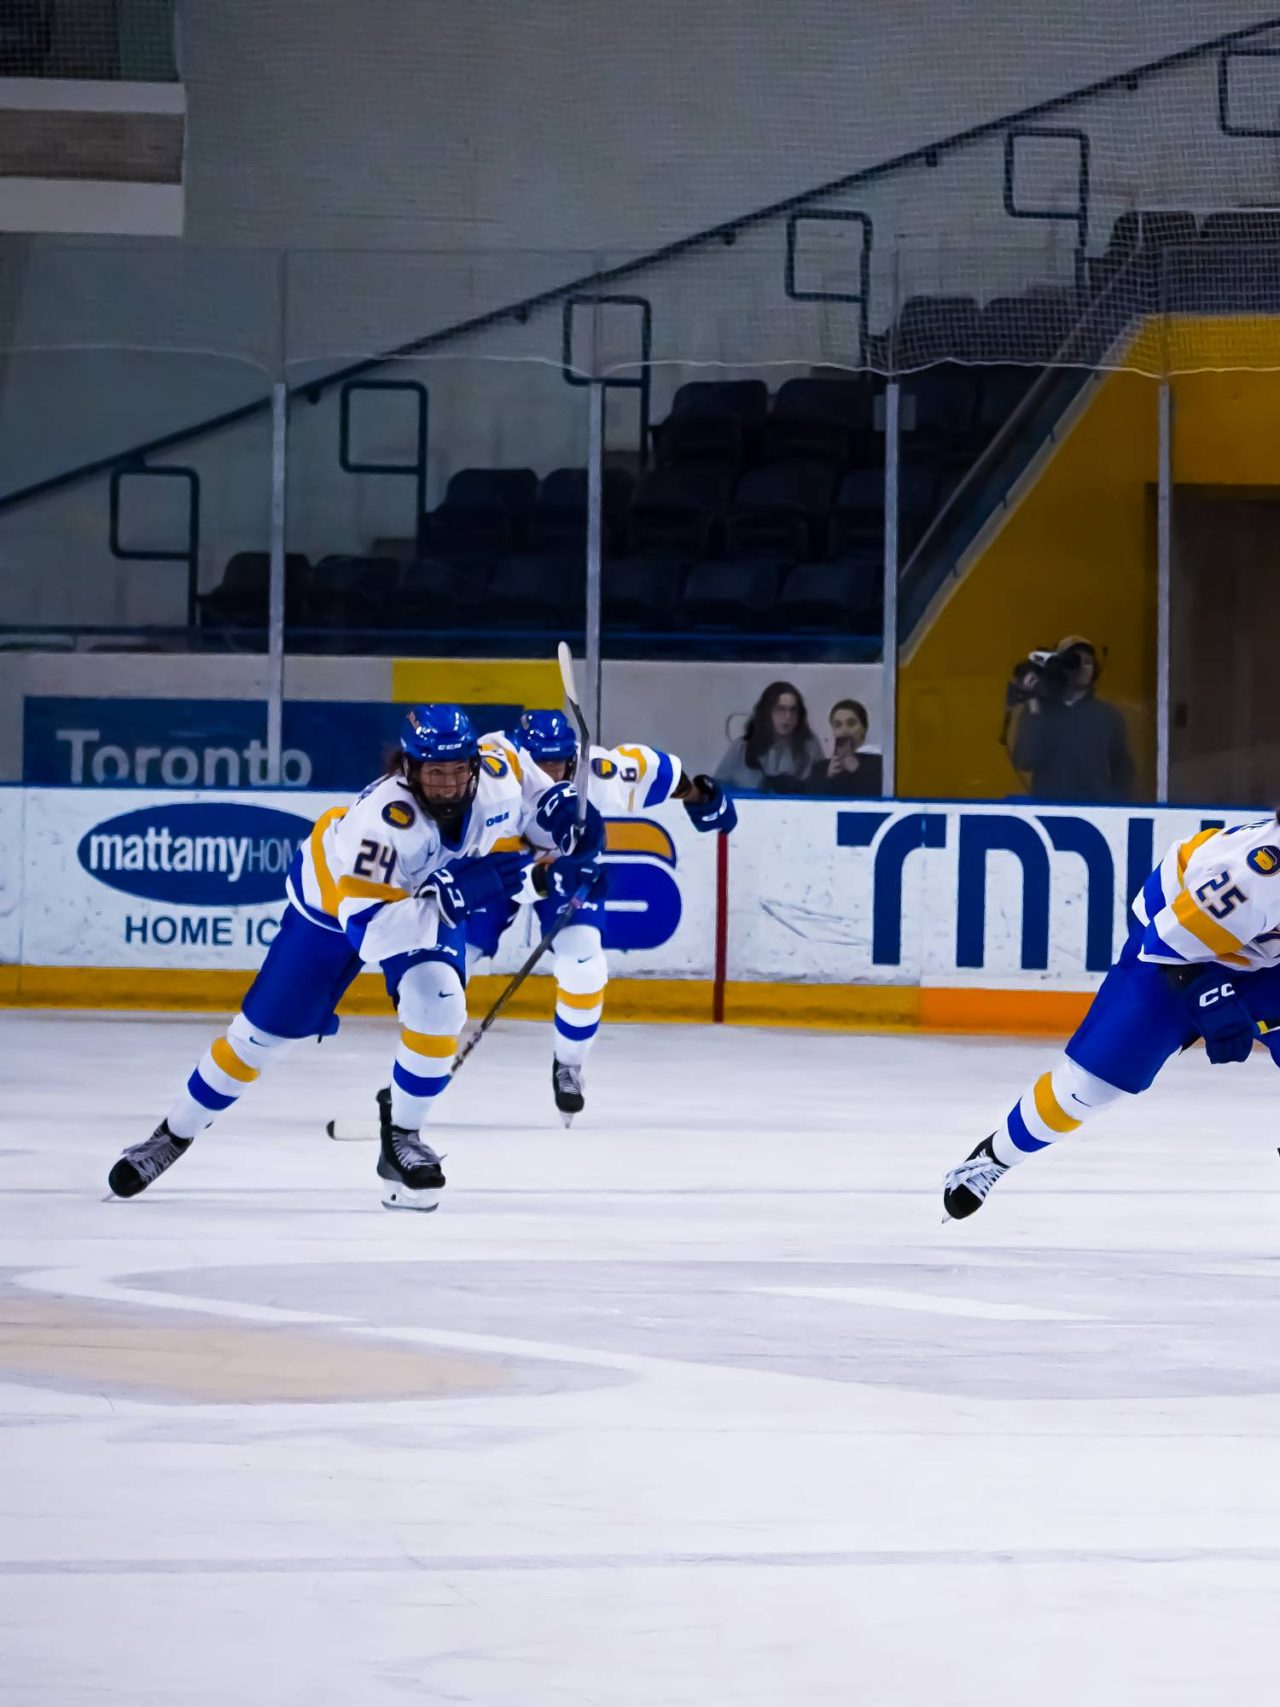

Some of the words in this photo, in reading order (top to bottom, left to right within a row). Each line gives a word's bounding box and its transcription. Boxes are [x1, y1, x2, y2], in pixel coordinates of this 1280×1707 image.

[56, 729, 312, 788] Toronto
[353, 838, 397, 885] 24
[1195, 870, 1249, 919] 25
[125, 915, 233, 945] HOME
